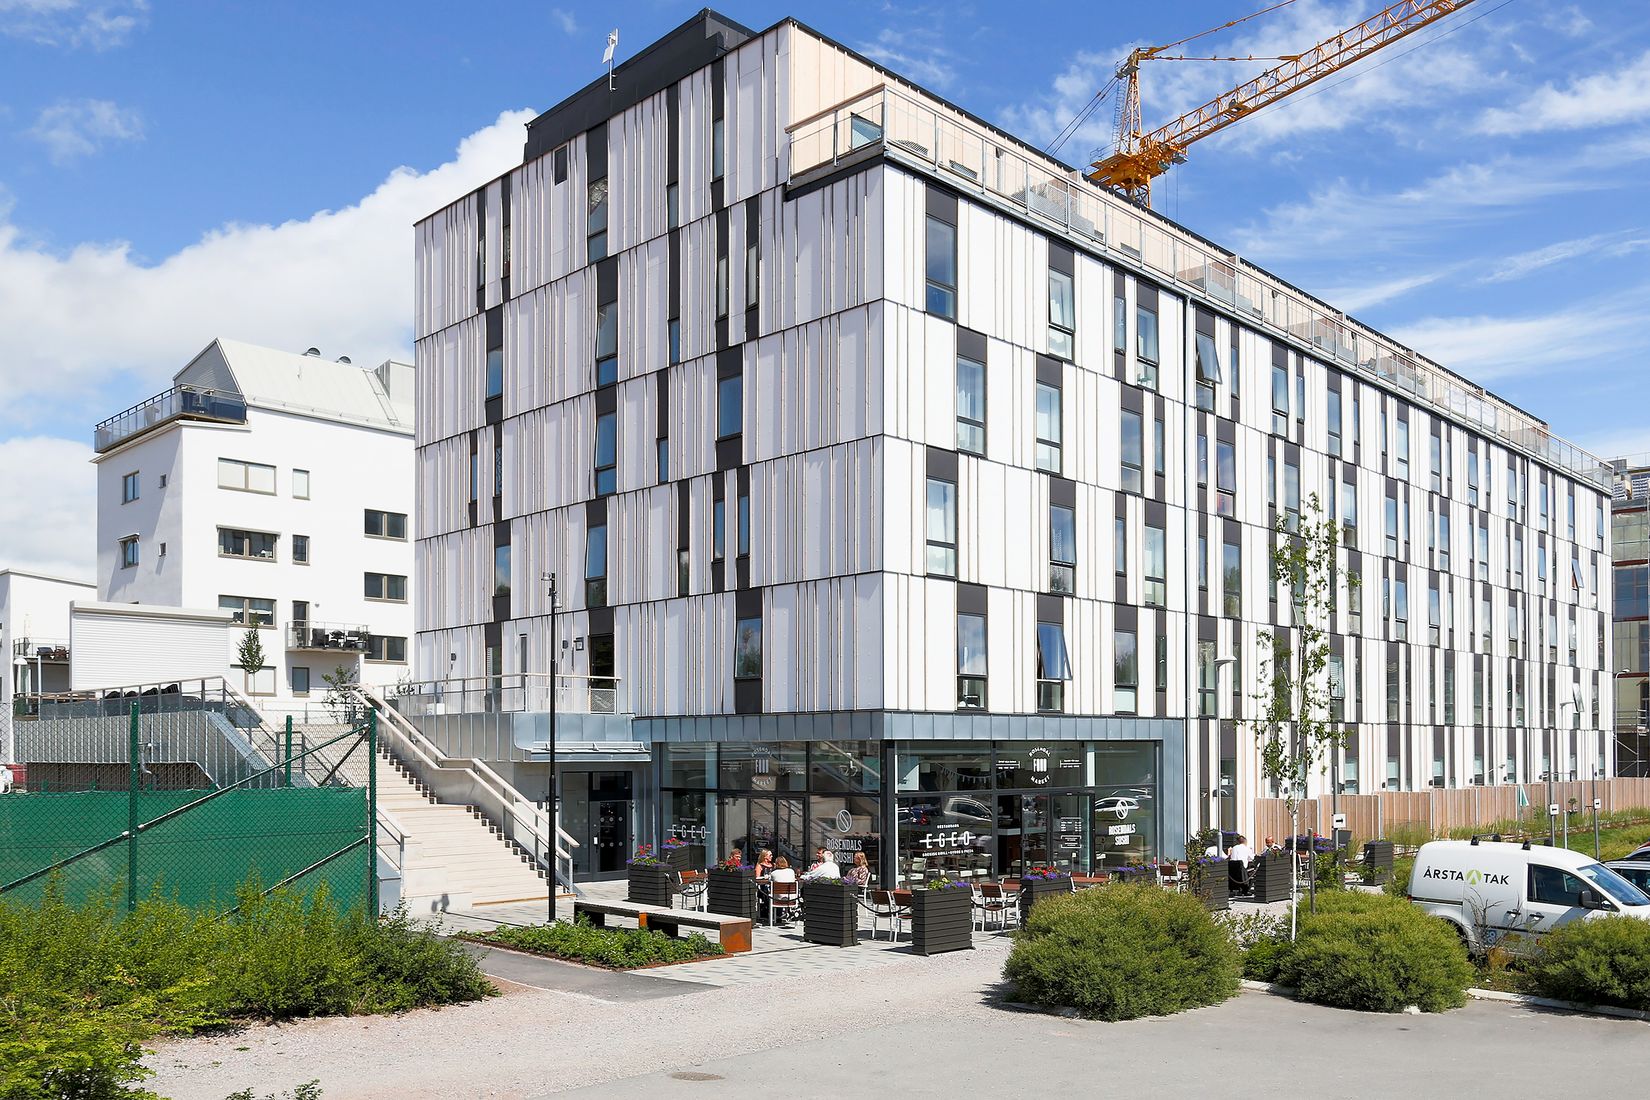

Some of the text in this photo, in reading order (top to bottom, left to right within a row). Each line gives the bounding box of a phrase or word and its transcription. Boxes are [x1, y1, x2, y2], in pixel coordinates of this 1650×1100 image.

[1030, 774, 1050, 785] MARKET
[671, 824, 706, 840] EGEO
[826, 838, 863, 851] ROSENDALS
[925, 830, 971, 849] EGEO
[834, 851, 854, 864] SUSHI
[1423, 865, 1510, 886] ÅRSTA TAK
